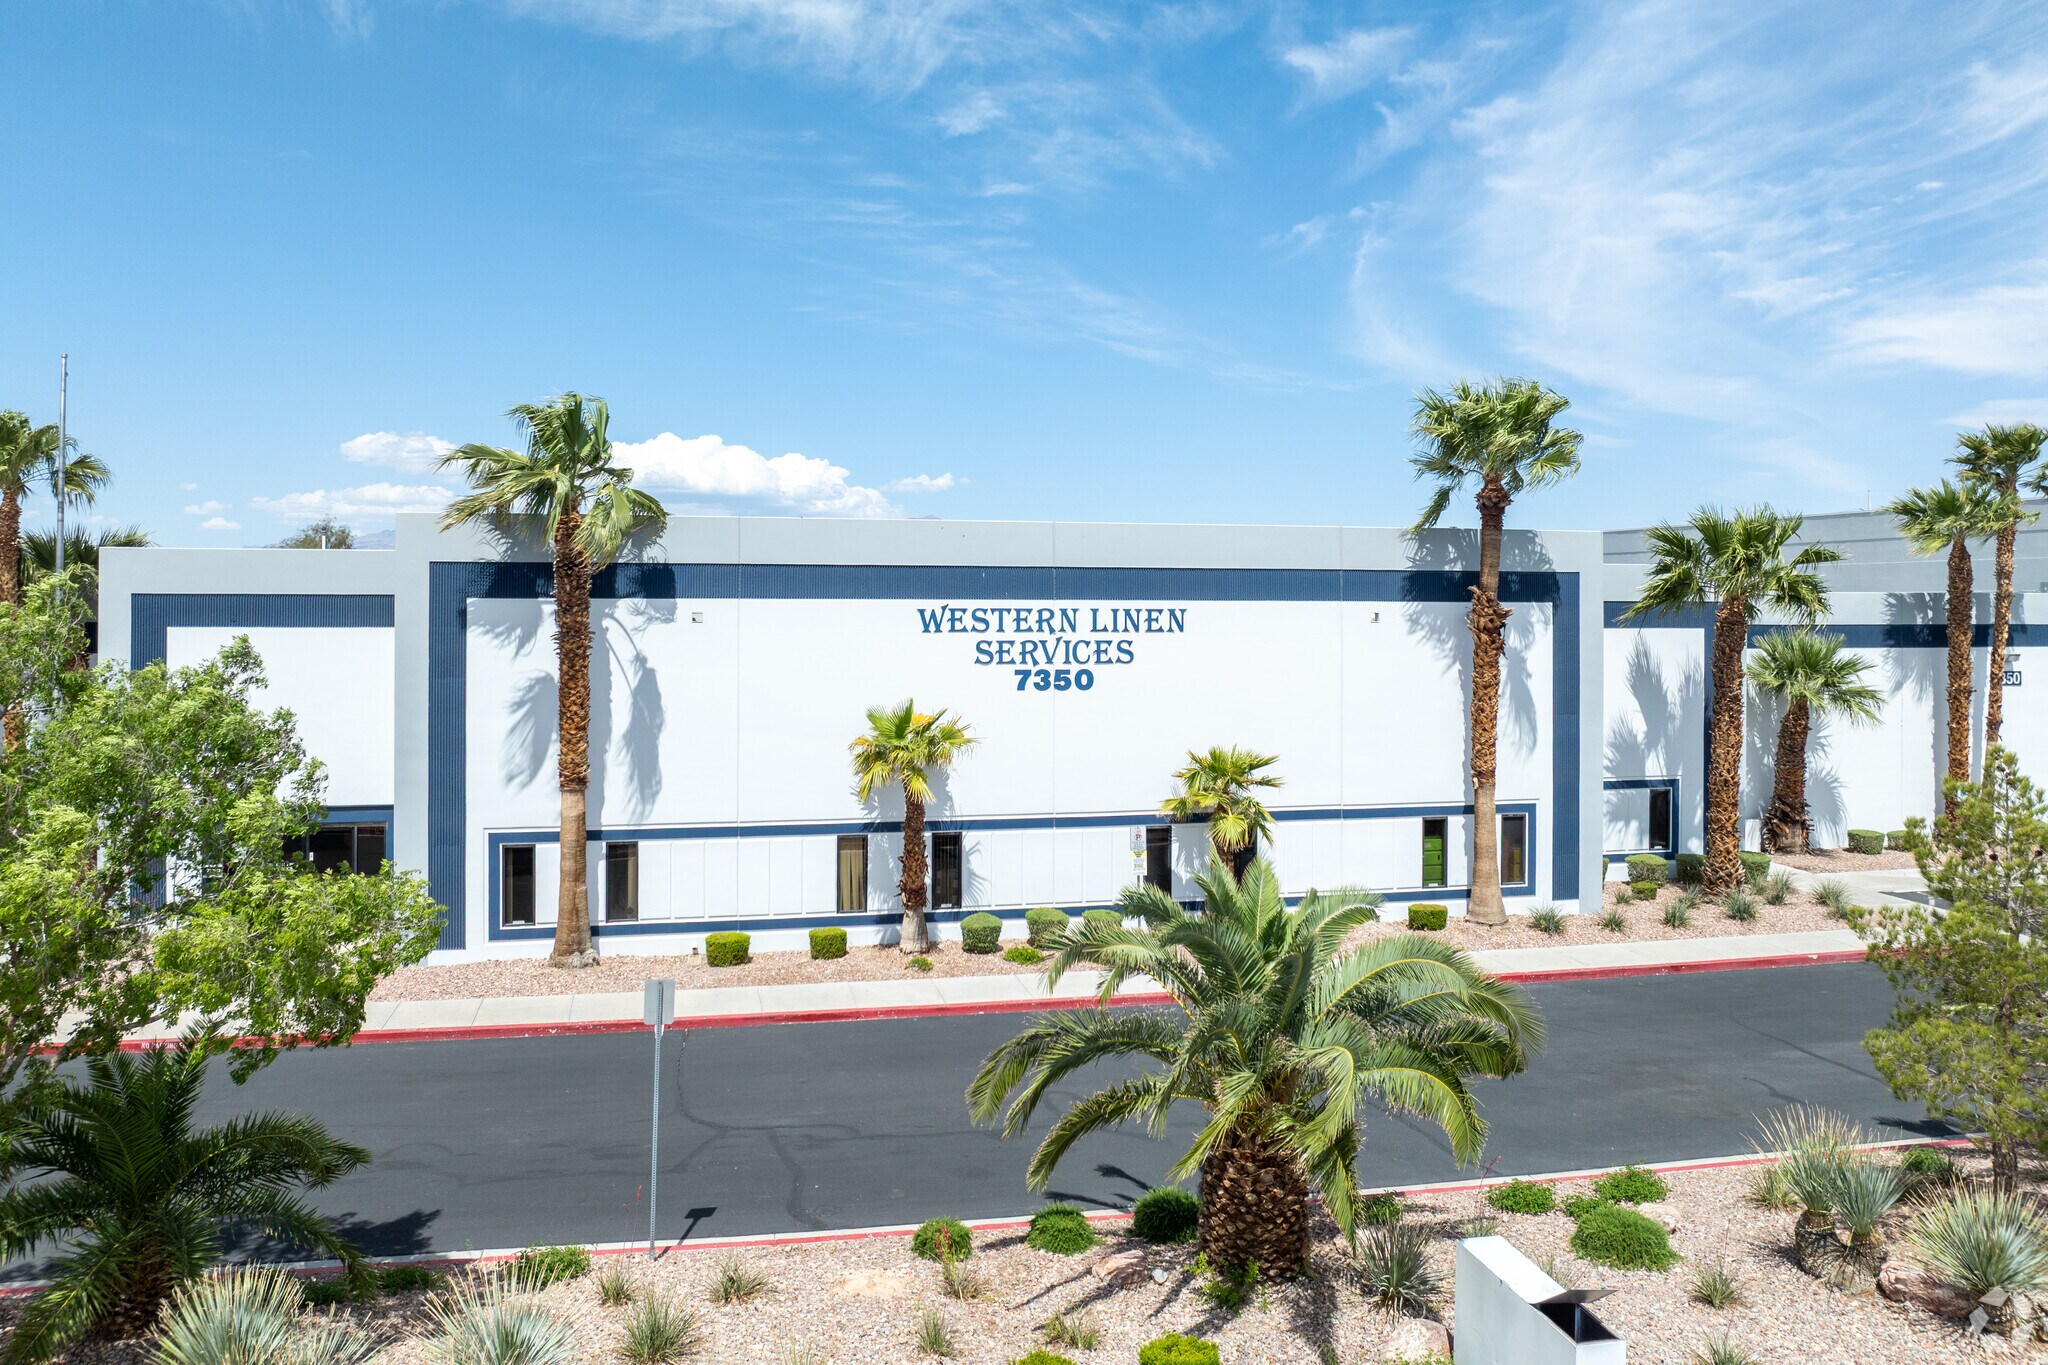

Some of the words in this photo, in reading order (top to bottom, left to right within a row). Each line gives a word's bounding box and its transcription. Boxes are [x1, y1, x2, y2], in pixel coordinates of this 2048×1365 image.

[917, 604, 1078, 634] WESTERN
[1090, 608, 1187, 633] LINEN
[974, 636, 1134, 667] SERVICES
[1015, 669, 1094, 691] 7350
